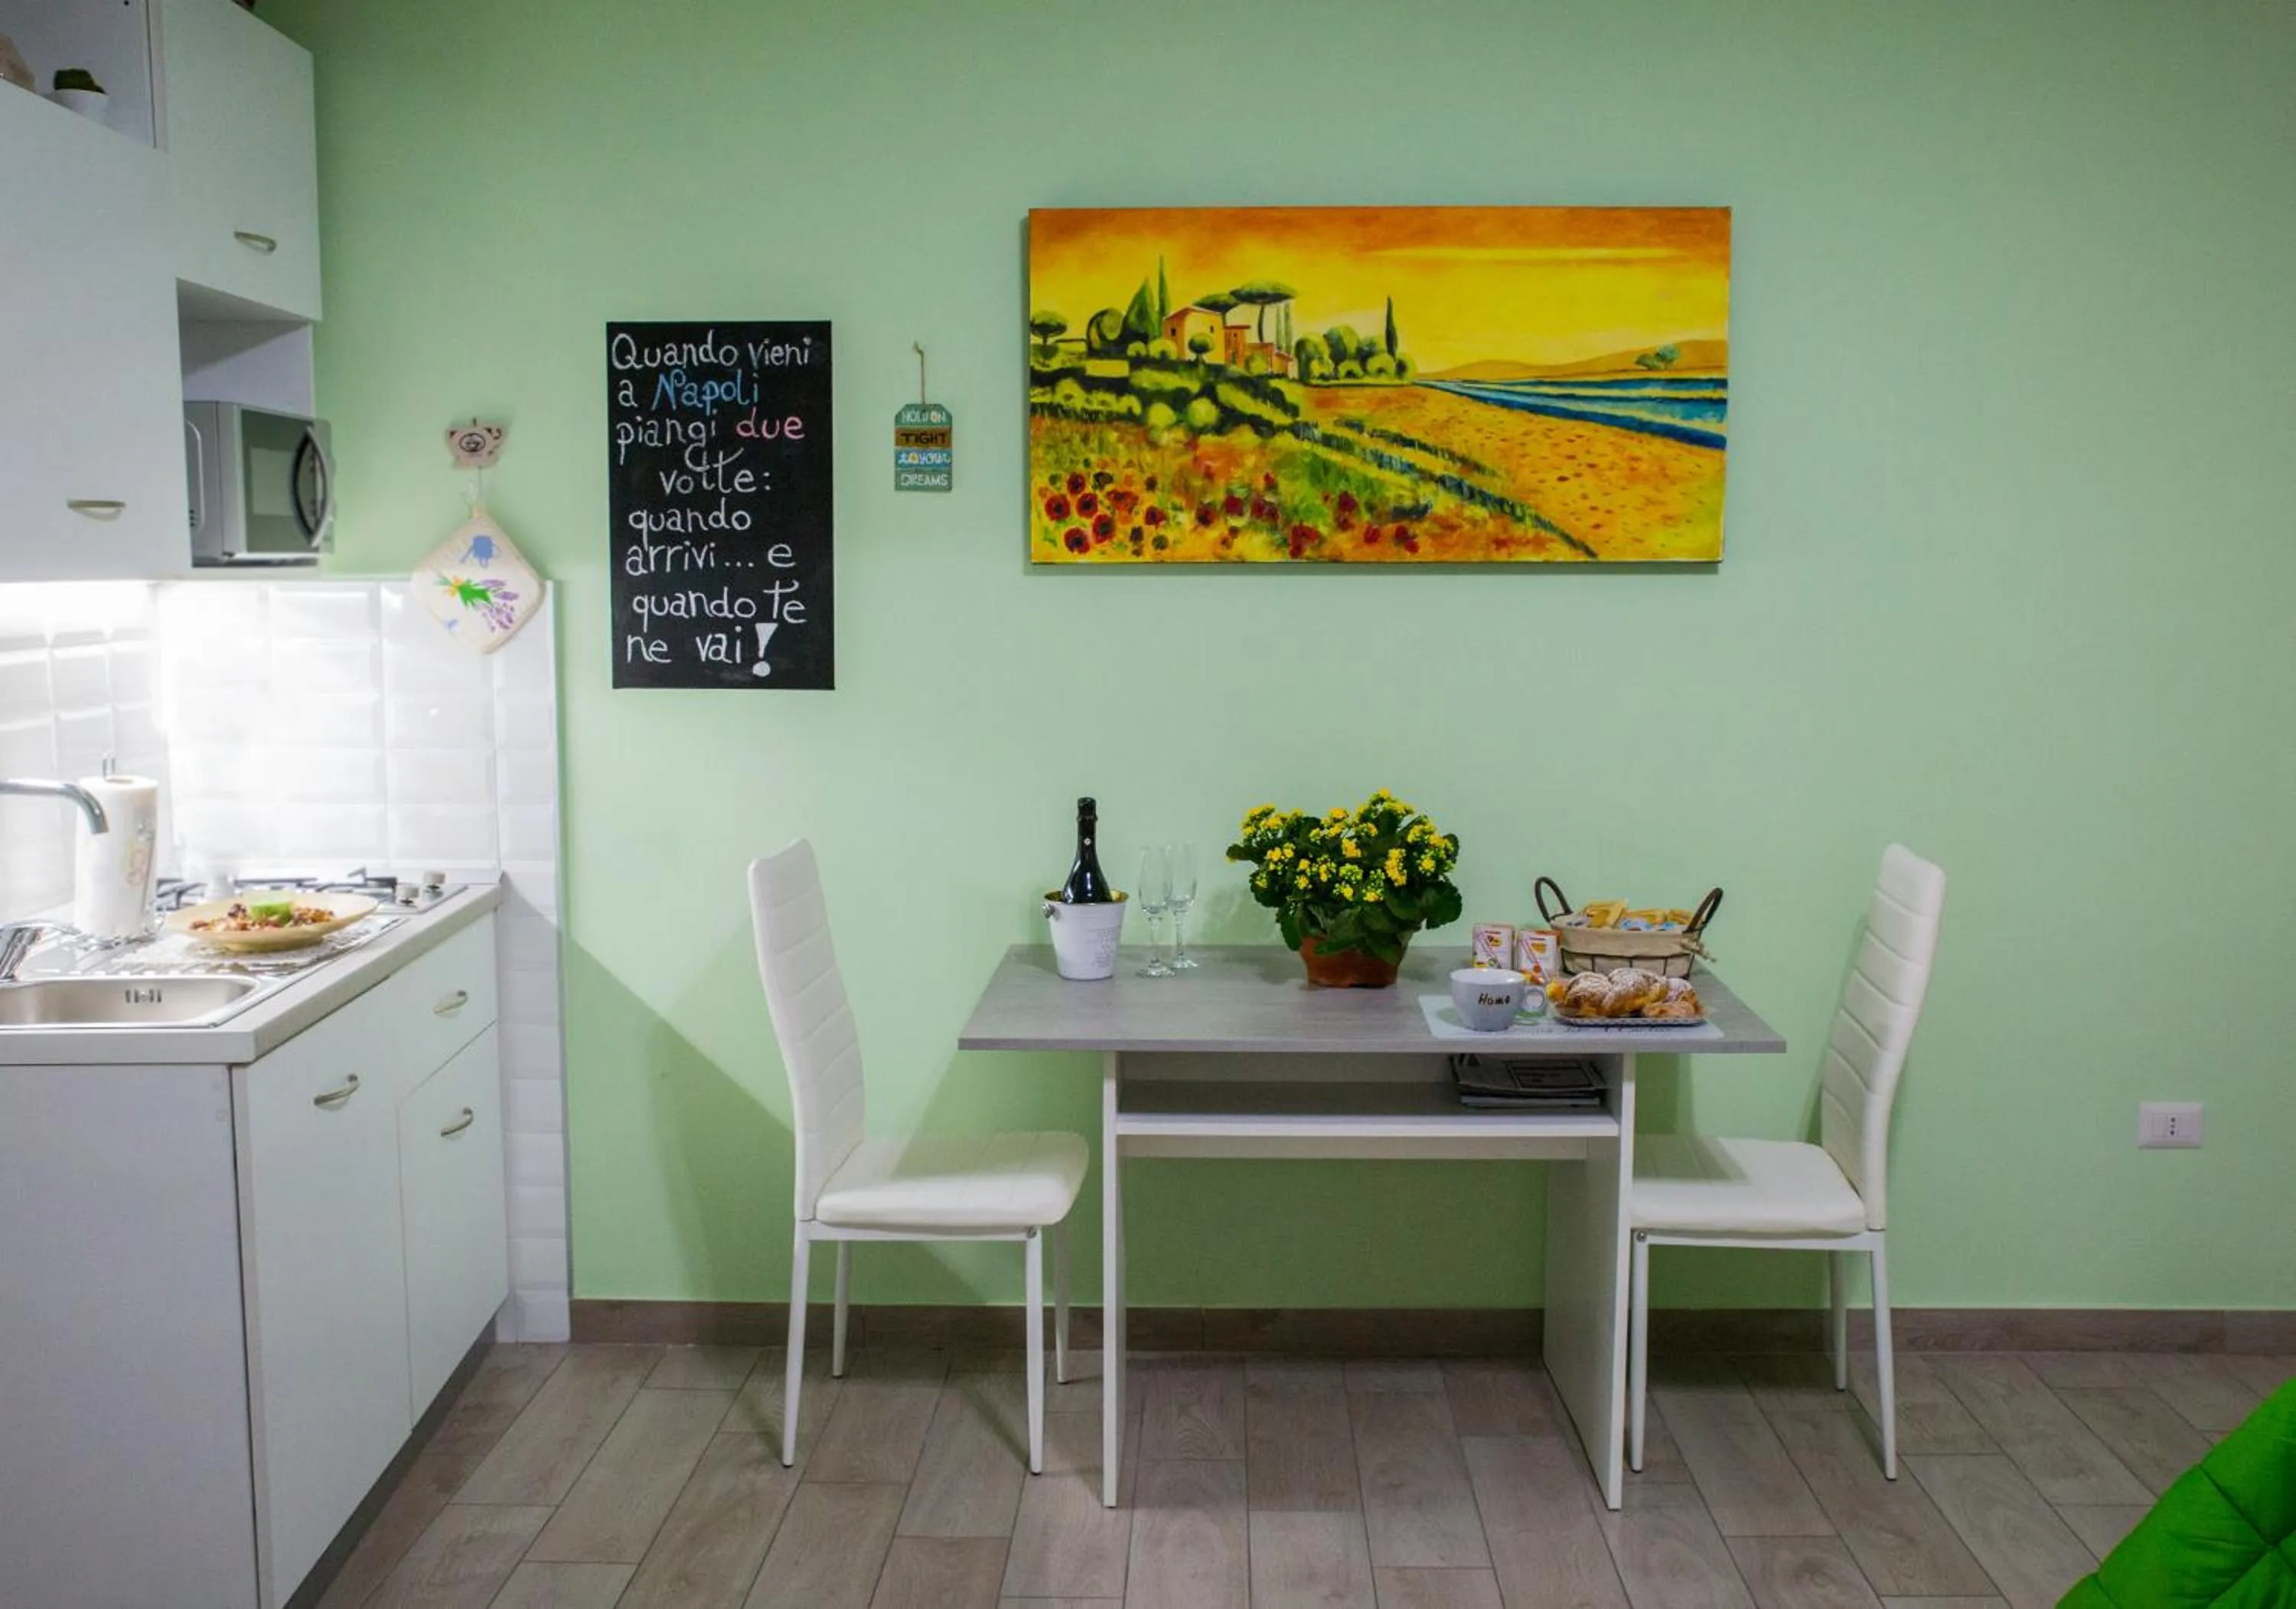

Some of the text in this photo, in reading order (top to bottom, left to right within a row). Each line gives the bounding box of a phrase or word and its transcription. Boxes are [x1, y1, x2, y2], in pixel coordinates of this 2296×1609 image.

[612, 329, 811, 370] Quando vieni
[618, 368, 758, 415] a Napoli
[930, 411, 947, 423] ON
[615, 406, 805, 472] piangi due
[901, 432, 946, 445] TIGHT
[660, 448, 771, 495] volte:
[901, 473, 948, 487] DREAMS
[629, 498, 751, 552] quando
[768, 543, 796, 568] e
[632, 586, 757, 632] quando
[627, 632, 672, 664] ne
[1478, 992, 1511, 1007] Home
